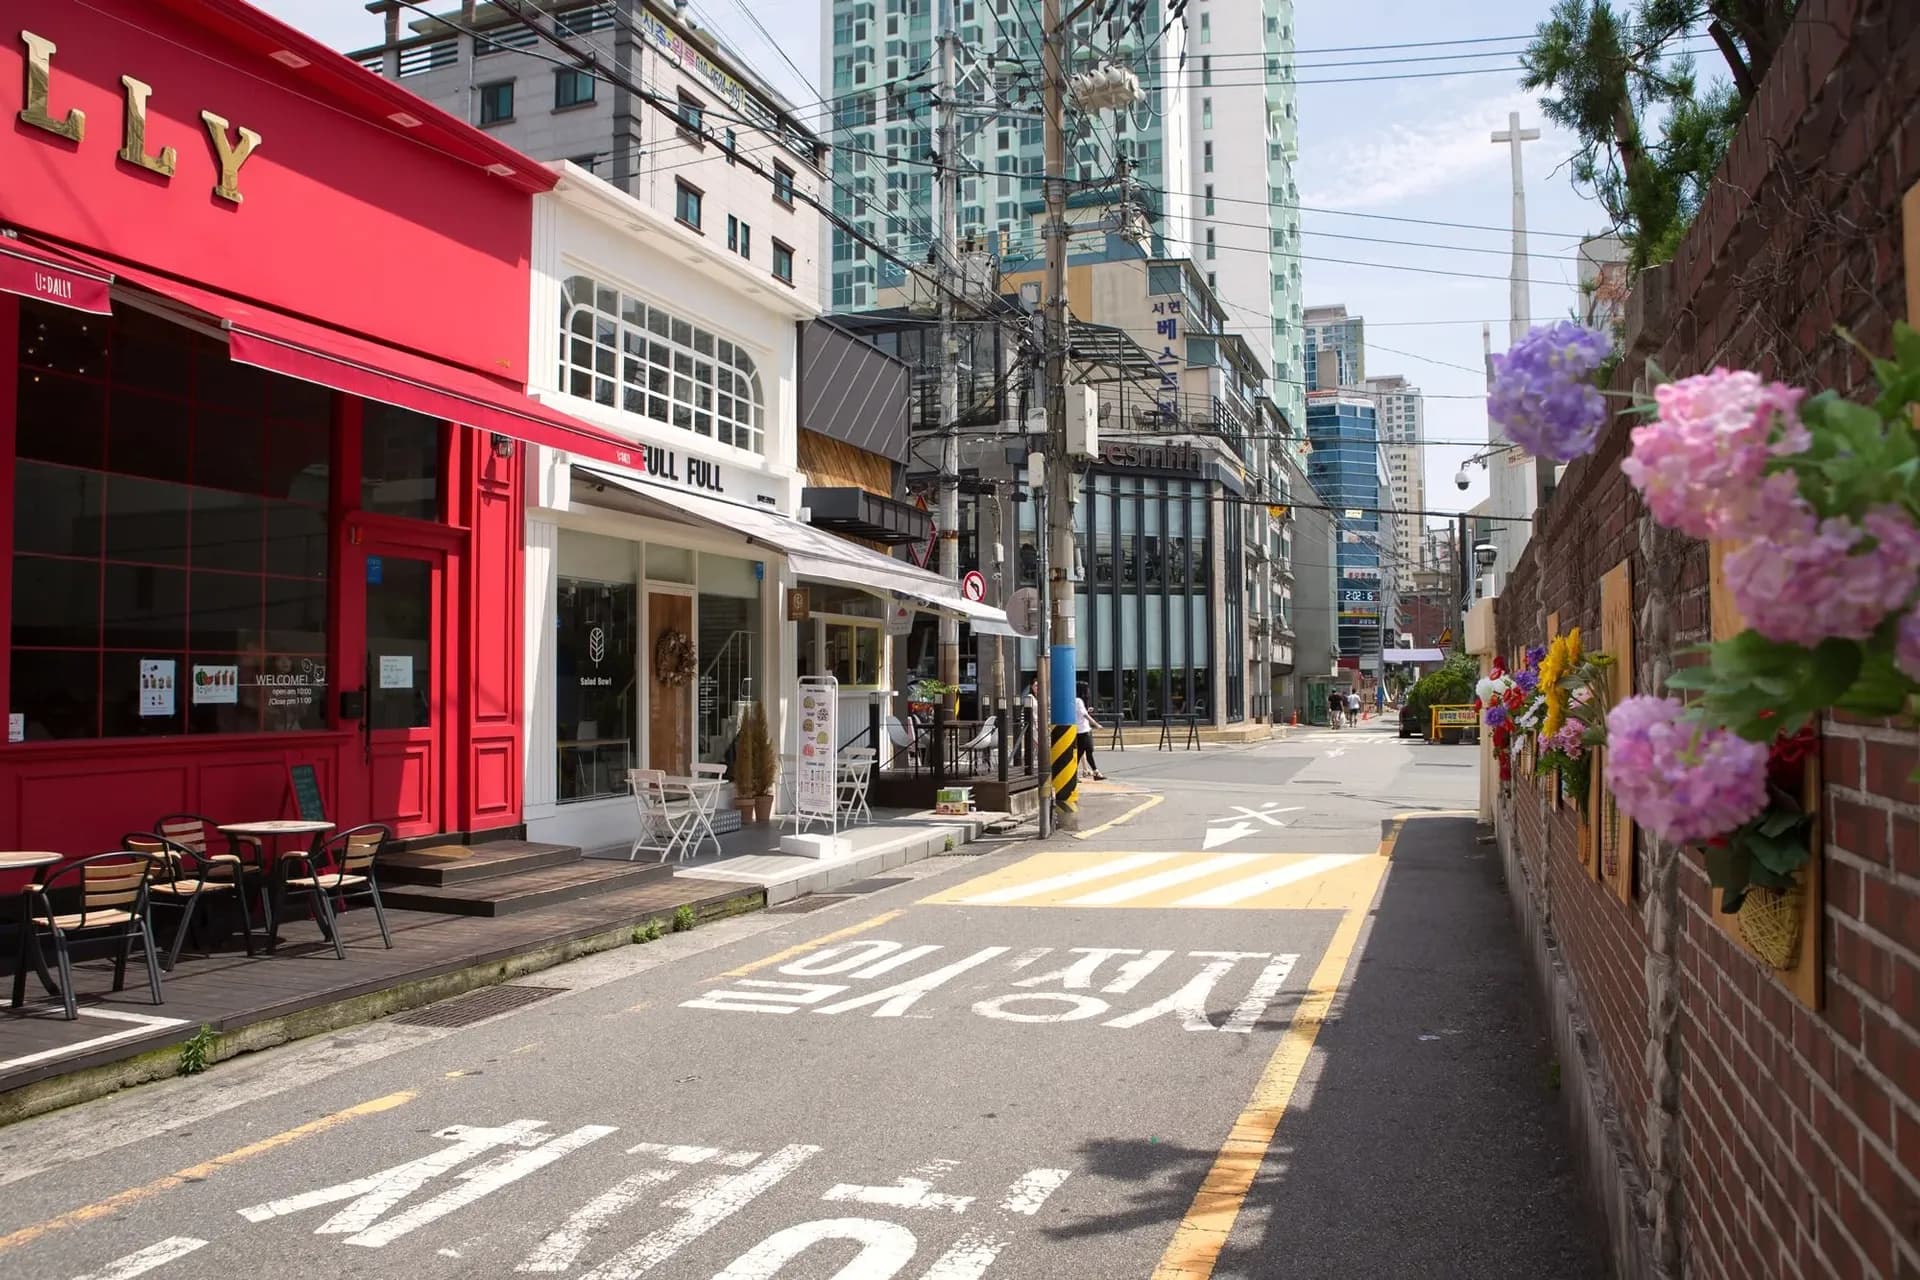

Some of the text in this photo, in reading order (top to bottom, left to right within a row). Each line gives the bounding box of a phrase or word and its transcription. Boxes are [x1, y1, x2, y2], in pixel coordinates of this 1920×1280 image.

[21, 29, 262, 204] LLY
[34, 272, 72, 298] U:DALLY
[1152, 300, 1181, 315] 서면
[686, 456, 724, 493] FULL
[256, 674, 308, 686] WELCOME!
[580, 677, 597, 686] Salad
